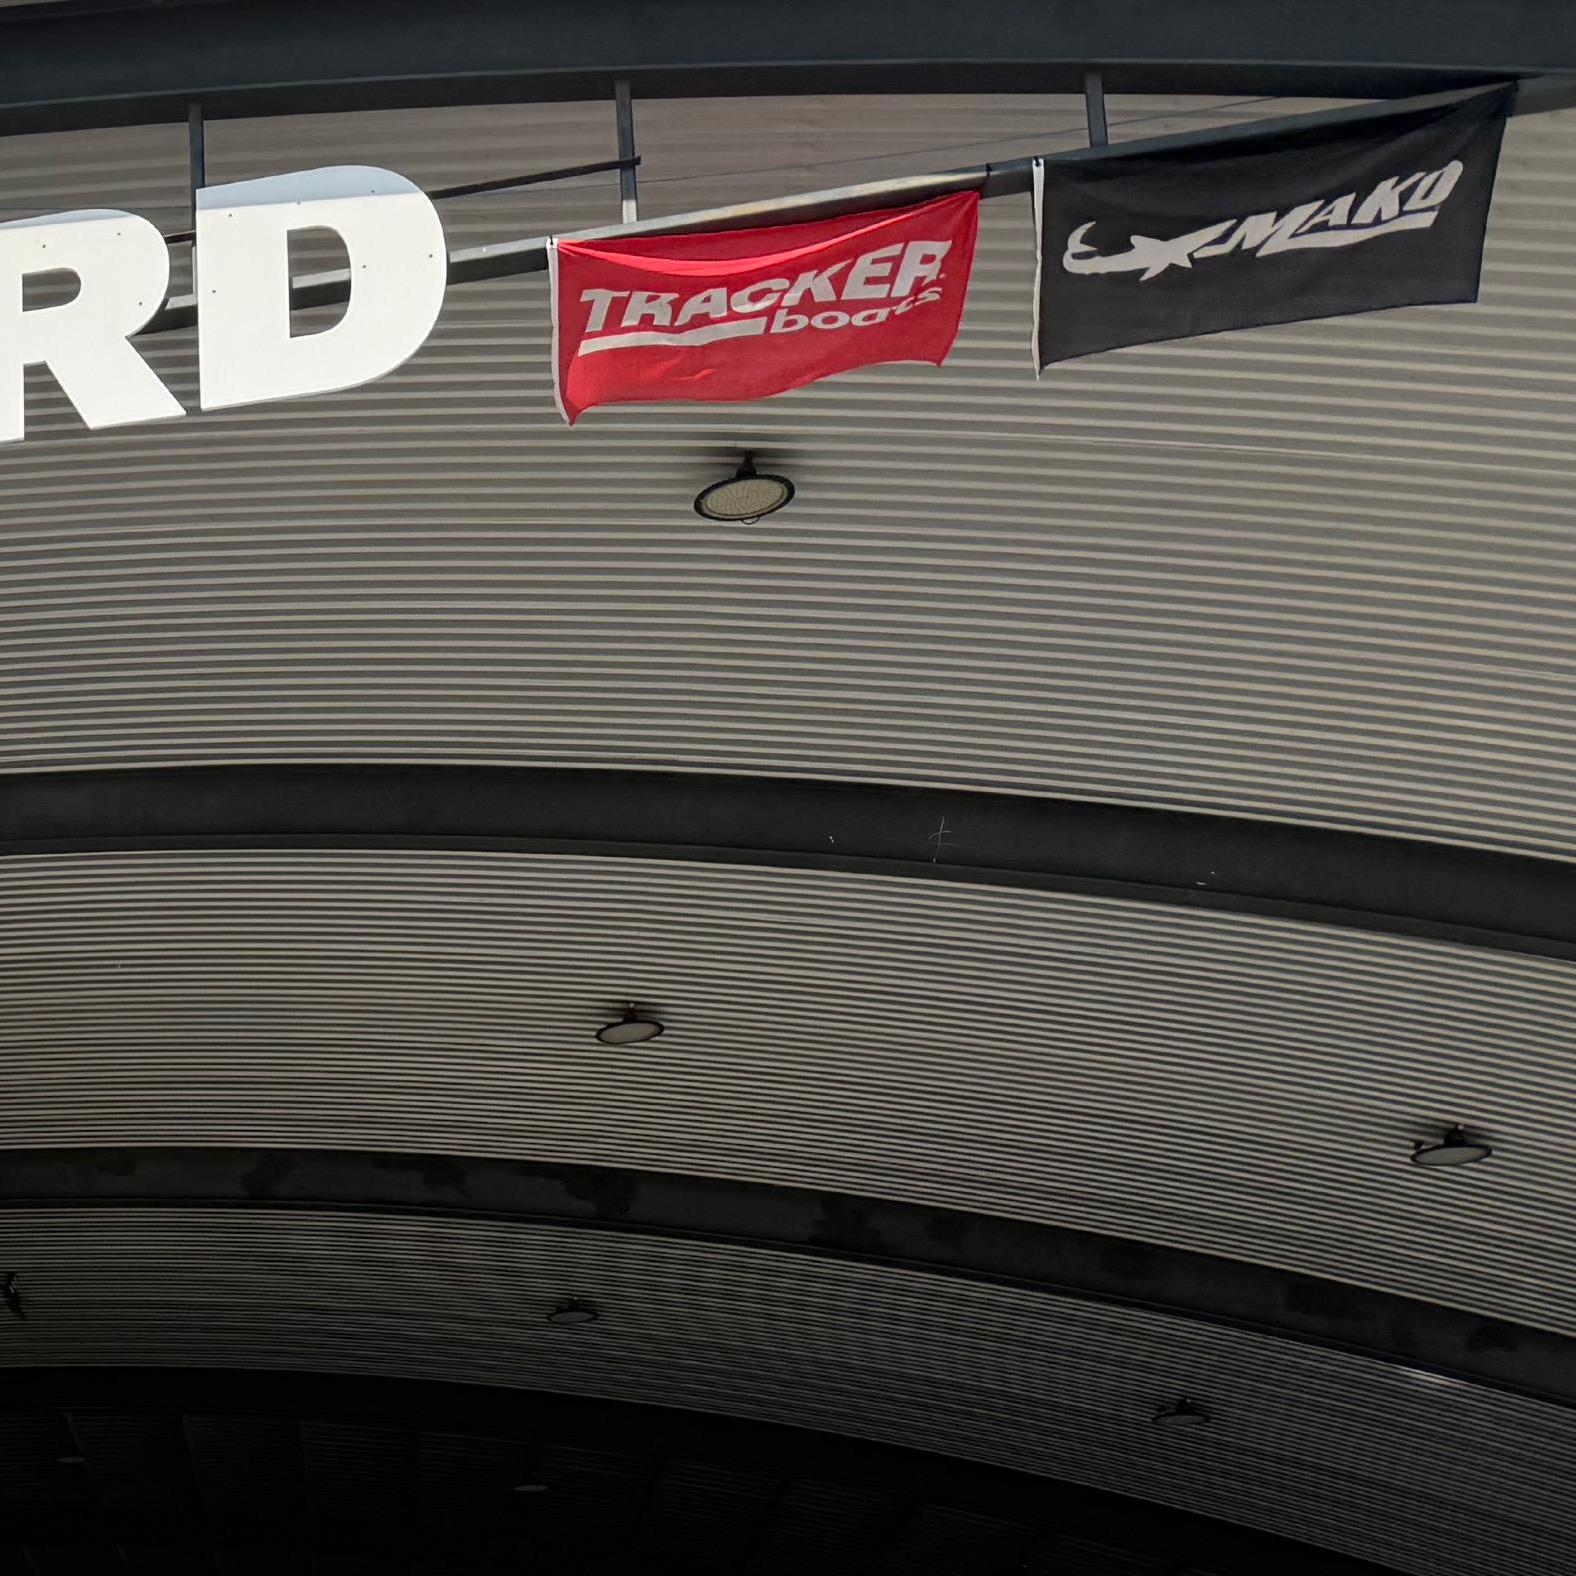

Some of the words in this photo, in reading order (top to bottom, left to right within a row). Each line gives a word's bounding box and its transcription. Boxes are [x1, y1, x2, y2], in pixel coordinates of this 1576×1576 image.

[1193, 159, 1464, 258] MAKO
[579, 239, 952, 334] TRACKER
[770, 286, 943, 335] boats
